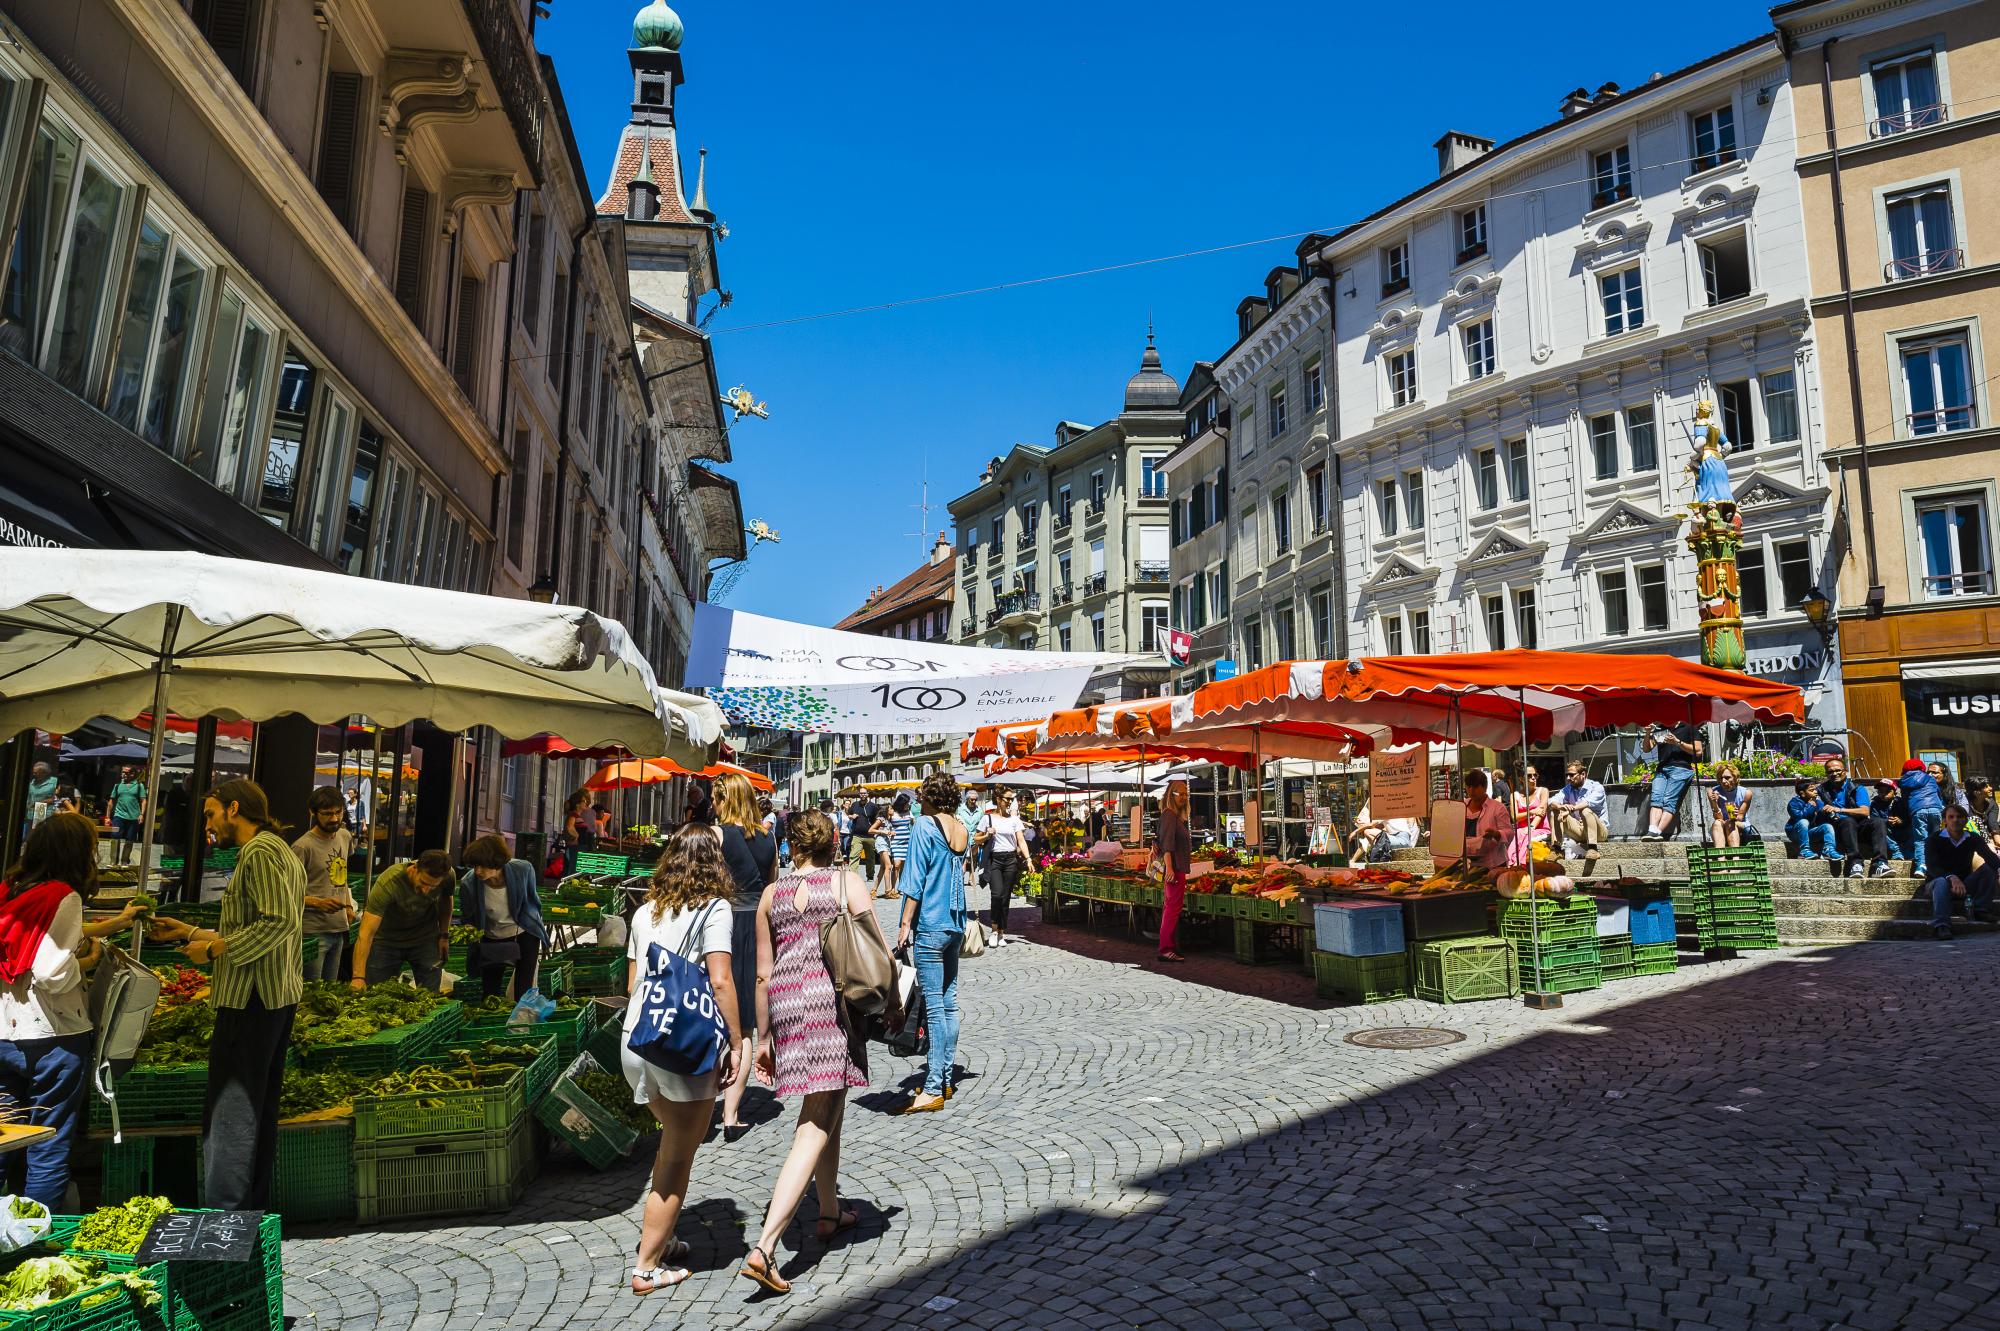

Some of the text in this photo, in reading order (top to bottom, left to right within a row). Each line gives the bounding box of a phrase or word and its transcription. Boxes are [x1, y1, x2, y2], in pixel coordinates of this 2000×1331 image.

[870, 683, 967, 711] 100
[980, 688, 1013, 697] ANS
[976, 695, 1057, 706] ENSEMBLE
[1323, 764, 1332, 772] La
[1333, 763, 1358, 771] Mason
[1359, 761, 1368, 769] du
